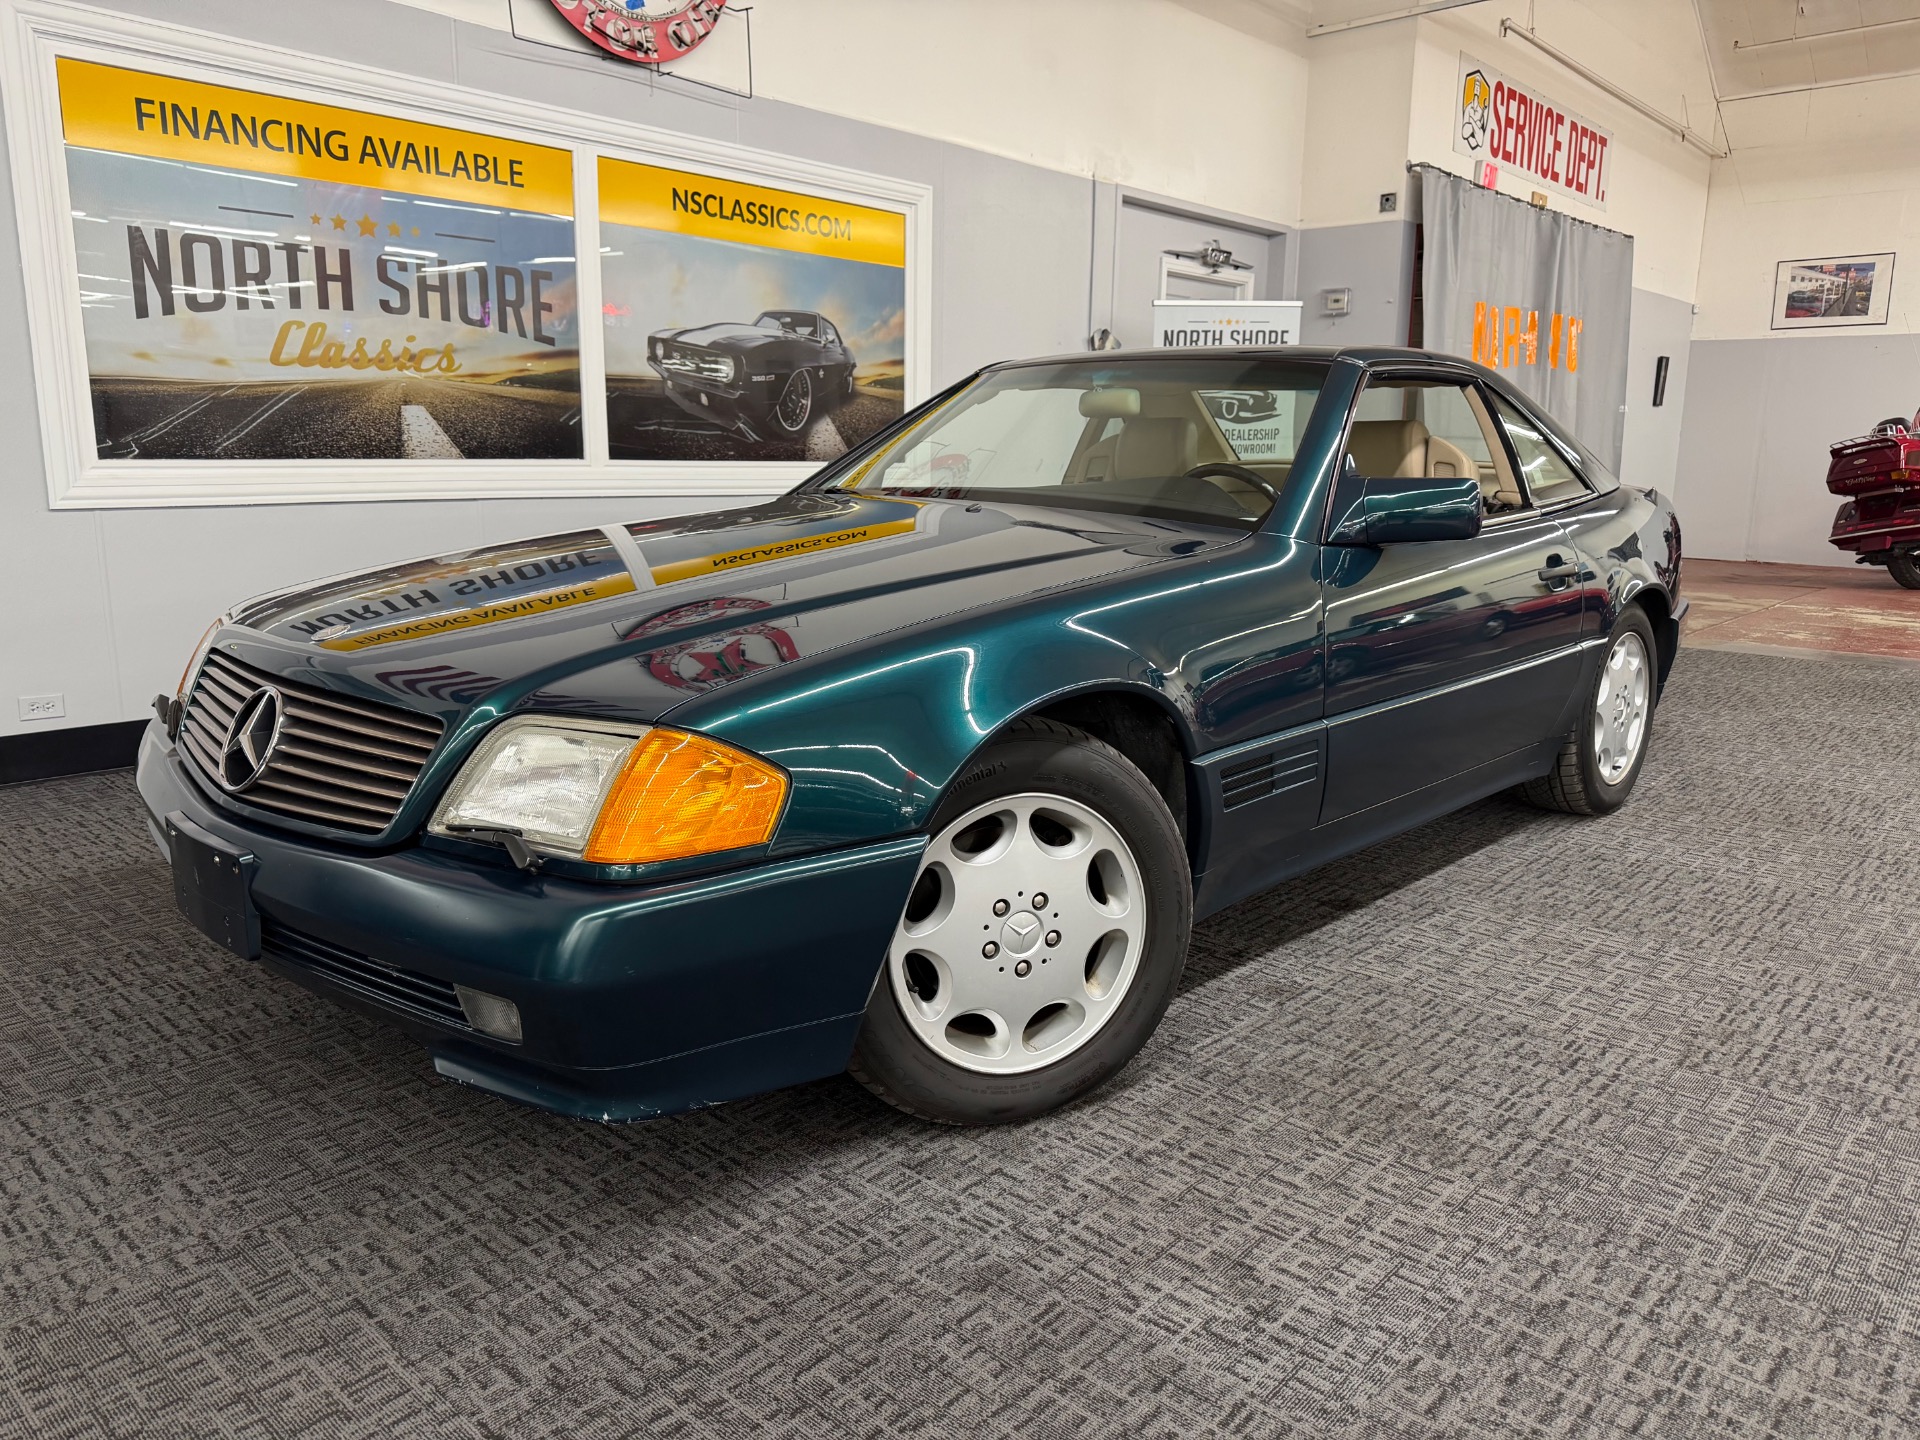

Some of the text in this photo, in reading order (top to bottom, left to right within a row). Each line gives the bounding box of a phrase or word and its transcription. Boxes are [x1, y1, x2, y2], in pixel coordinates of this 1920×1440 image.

[610, 4, 624, 15] THE
[134, 97, 525, 188] FINANCING AVAILABLE
[1490, 80, 1608, 202] SERVICE DEPT.
[672, 187, 852, 241] NSCLASSICS.COM
[127, 225, 556, 346] NORTH SHORE
[269, 320, 462, 374] Classics
[1163, 329, 1289, 347] NORTH SHORE
[1224, 427, 1280, 440] DEALERSHIP
[1231, 443, 1276, 454] HOWROOM!
